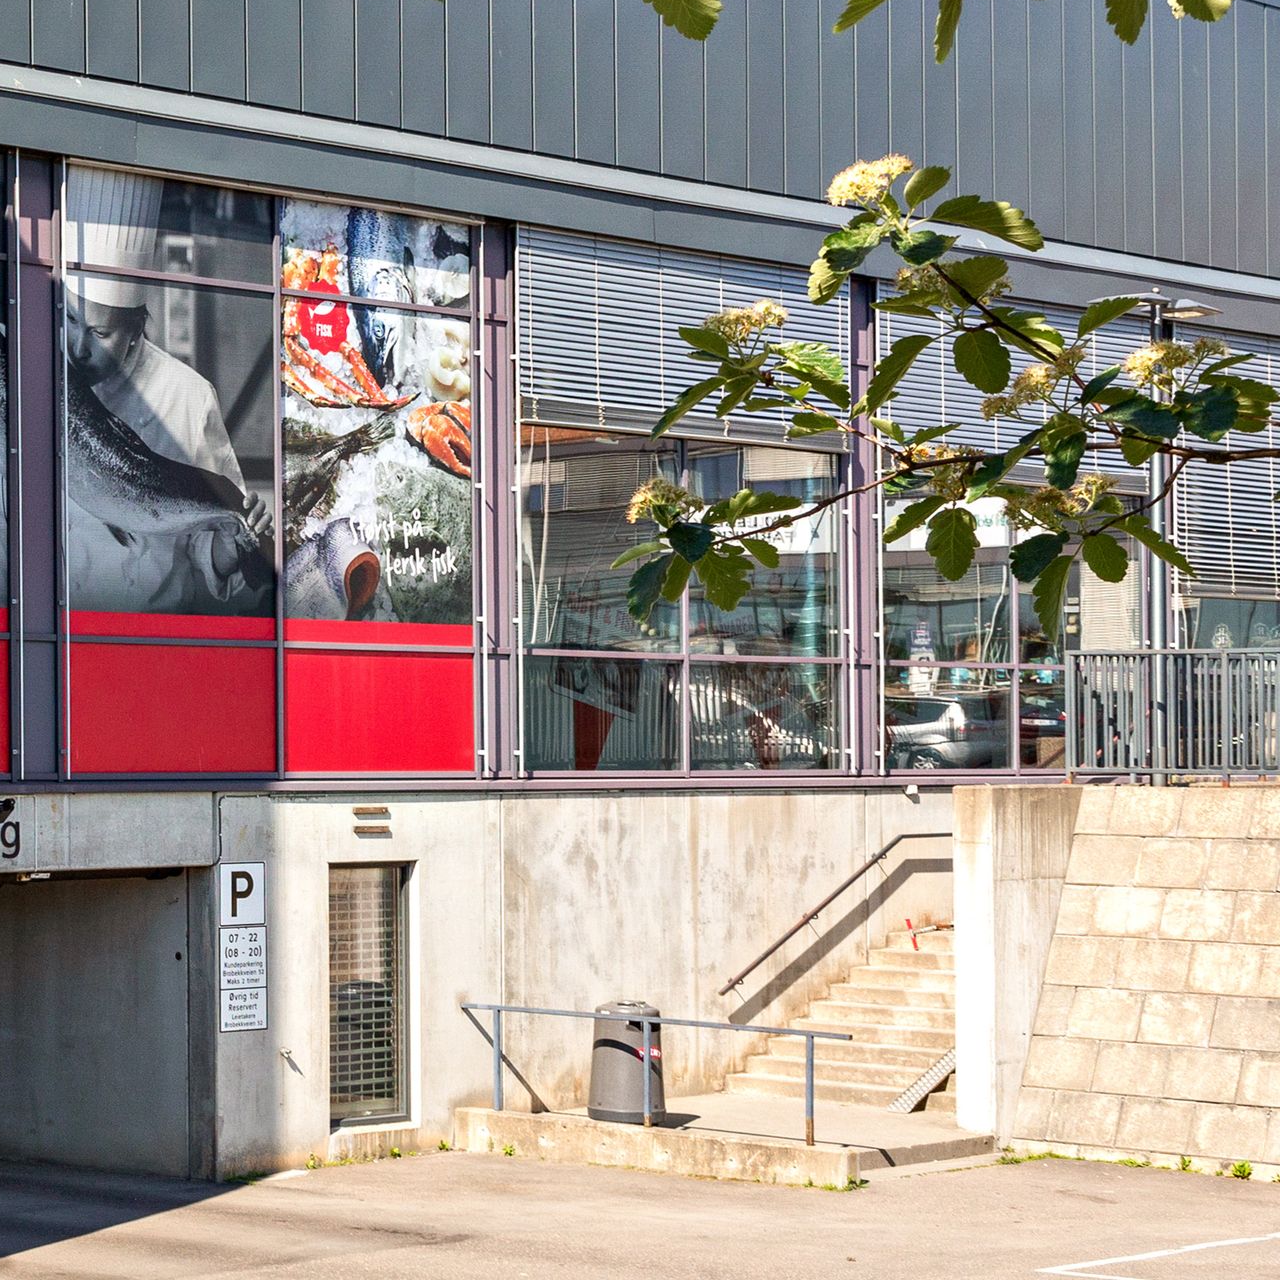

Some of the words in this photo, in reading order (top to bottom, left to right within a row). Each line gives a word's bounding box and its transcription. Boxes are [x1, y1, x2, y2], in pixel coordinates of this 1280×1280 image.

[403, 508, 424, 549] på
[385, 547, 426, 587] fersk
[431, 546, 457, 583] fisk
[231, 871, 254, 917] P
[229, 933, 239, 943] 07
[249, 933, 258, 942] 22
[225, 946, 239, 958] (08
[249, 945, 262, 957] 20)
[229, 992, 247, 1002] Øvrig
[250, 991, 259, 1000] tid
[229, 1003, 258, 1011] Reservert
